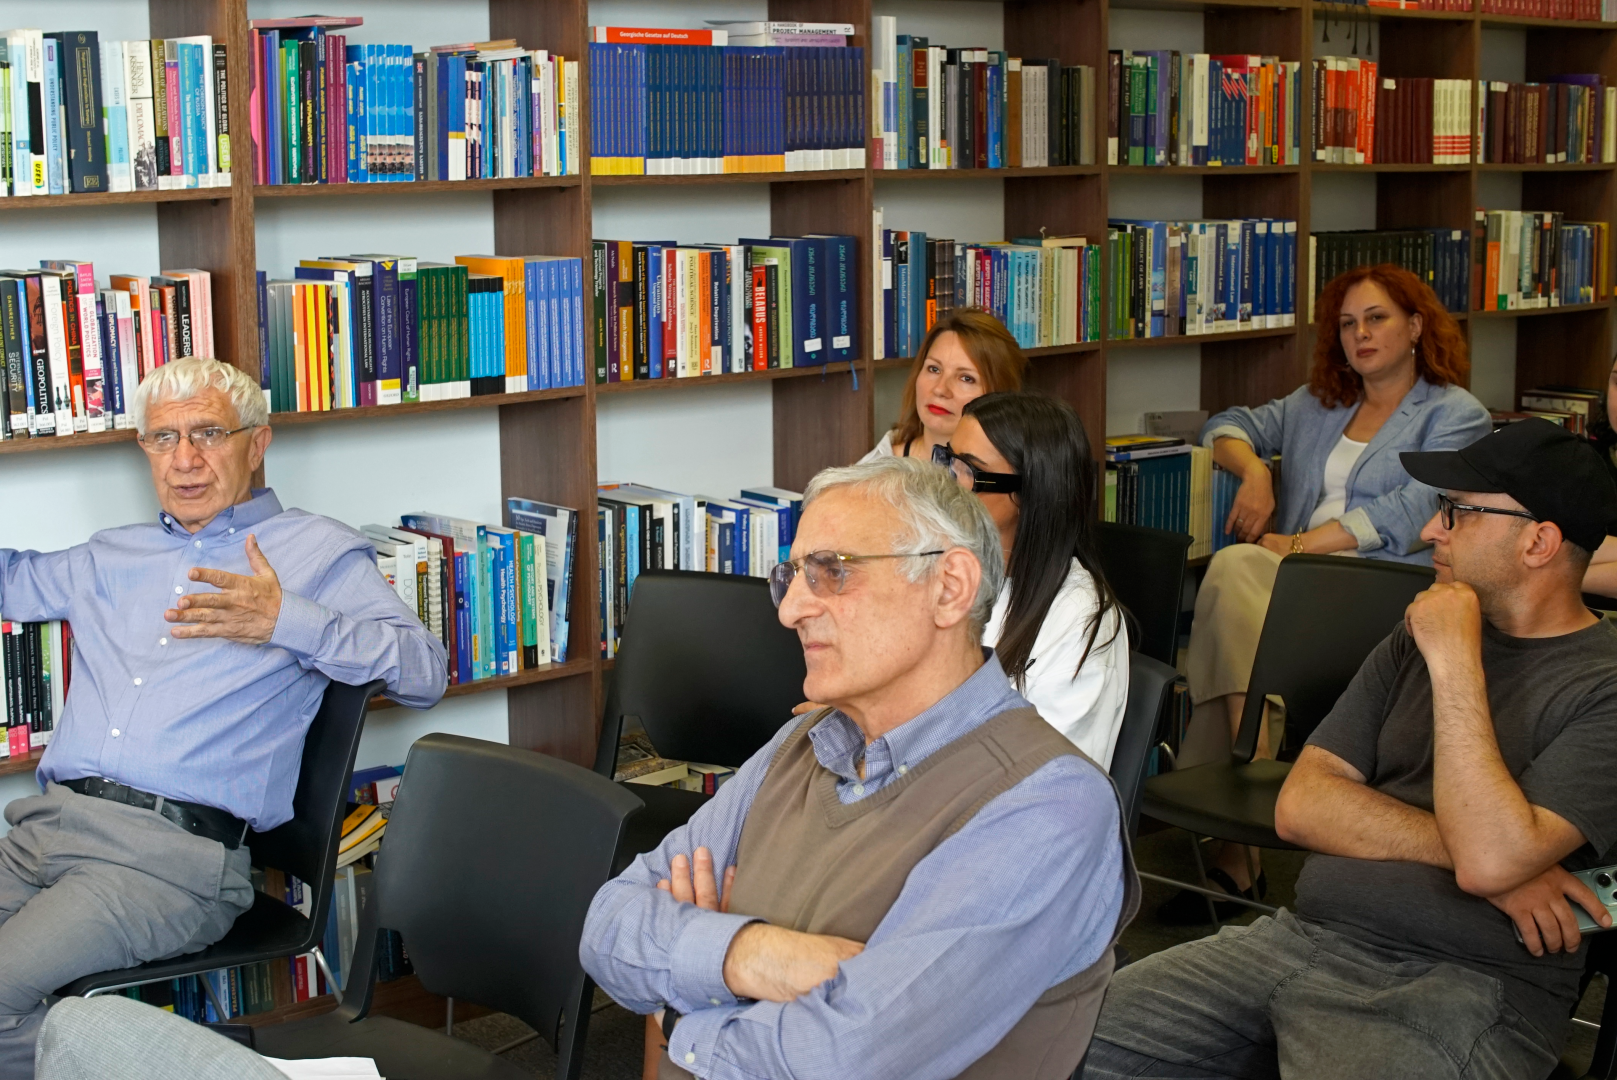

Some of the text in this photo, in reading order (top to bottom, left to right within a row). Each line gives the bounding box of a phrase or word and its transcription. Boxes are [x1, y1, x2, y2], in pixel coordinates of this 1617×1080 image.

[620, 31, 644, 39] Georgische
[130, 55, 138, 94] KISSINGER
[136, 61, 144, 88] HENRY
[160, 79, 165, 87] OF
[67, 280, 75, 313] POLITICS
[755, 286, 765, 323] BELARUS
[7, 295, 15, 340] DANNREUTHER
[50, 303, 64, 362] Foreign Policy
[70, 314, 75, 322] IN
[89, 311, 98, 358] GLOBALIZATION
[181, 314, 191, 357] LEADERSH
[84, 331, 92, 358] POLITICS
[8, 352, 18, 392] SECURITY
[15, 352, 24, 392] INTERNATIONAL
[37, 359, 49, 414] GEOPOLITICS
[537, 585, 545, 626] PSYCHOLOGY
